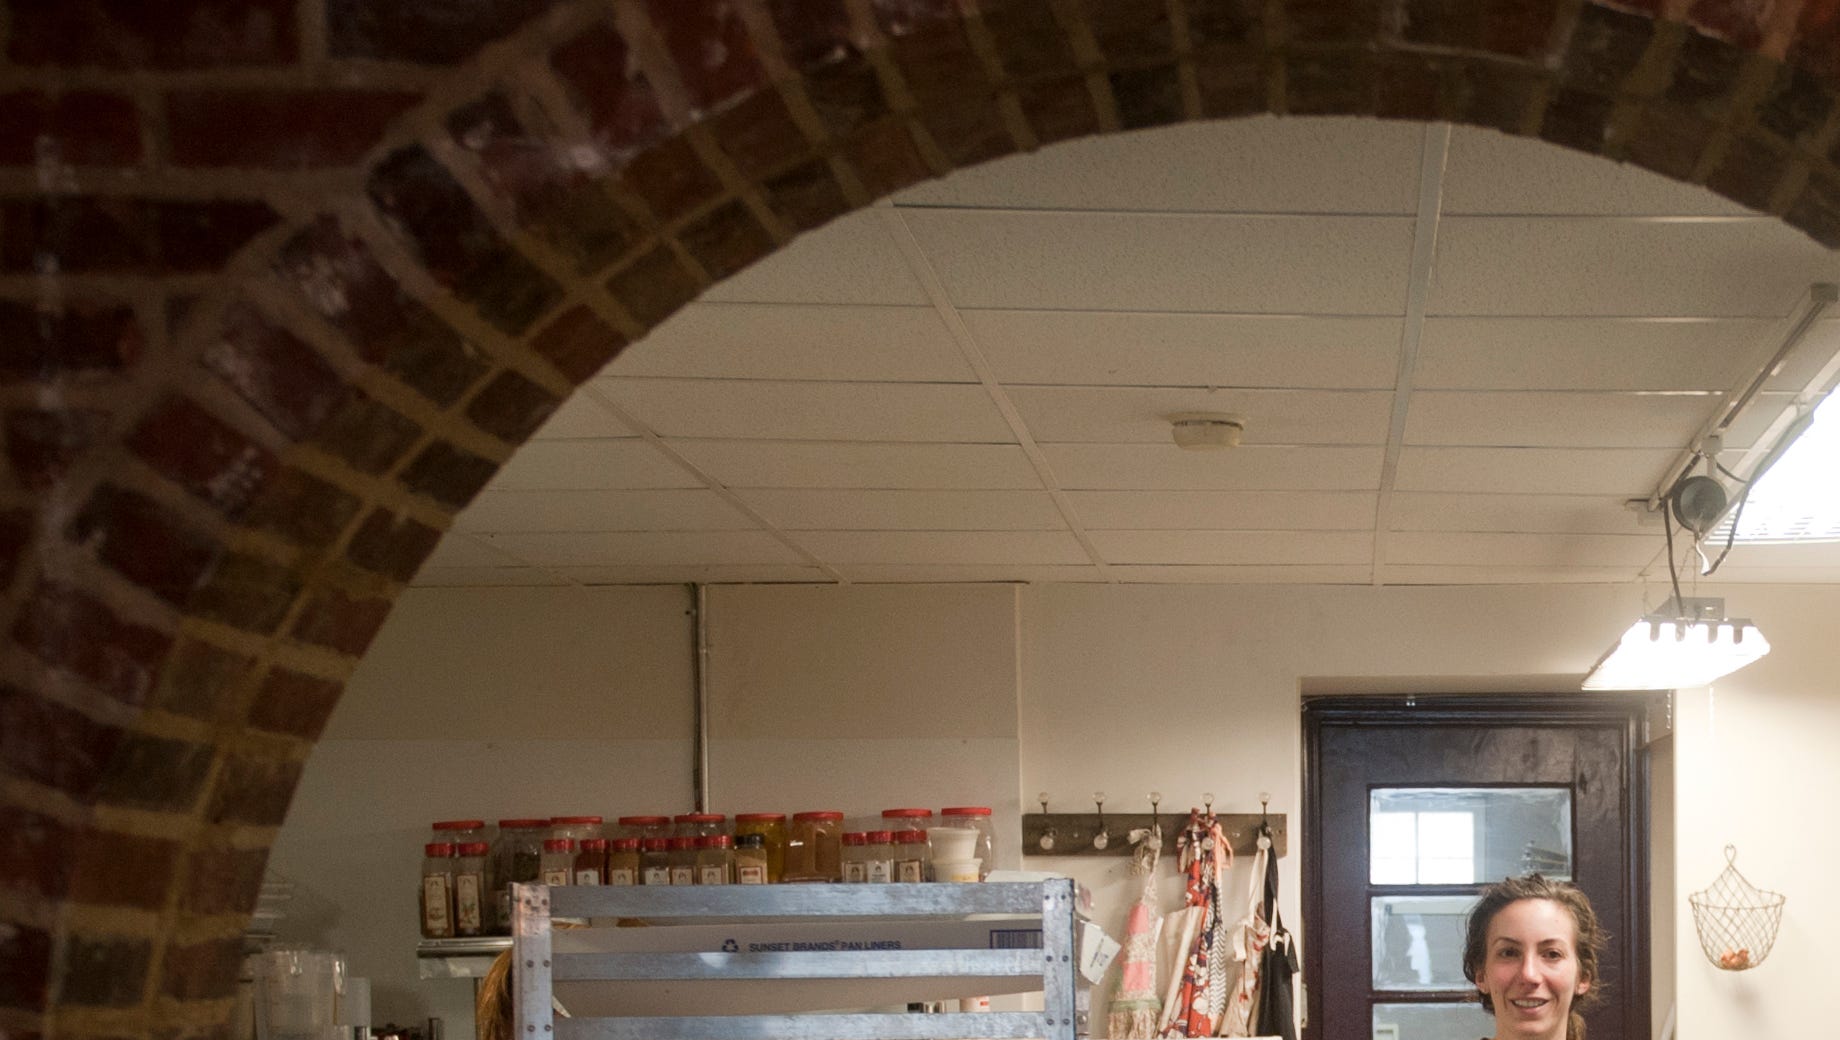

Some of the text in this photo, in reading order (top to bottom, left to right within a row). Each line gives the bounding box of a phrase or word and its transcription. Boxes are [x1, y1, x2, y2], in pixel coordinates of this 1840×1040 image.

[750, 942, 790, 952] SUNSET
[841, 941, 862, 950] PAN
[864, 940, 901, 950] LINERS
